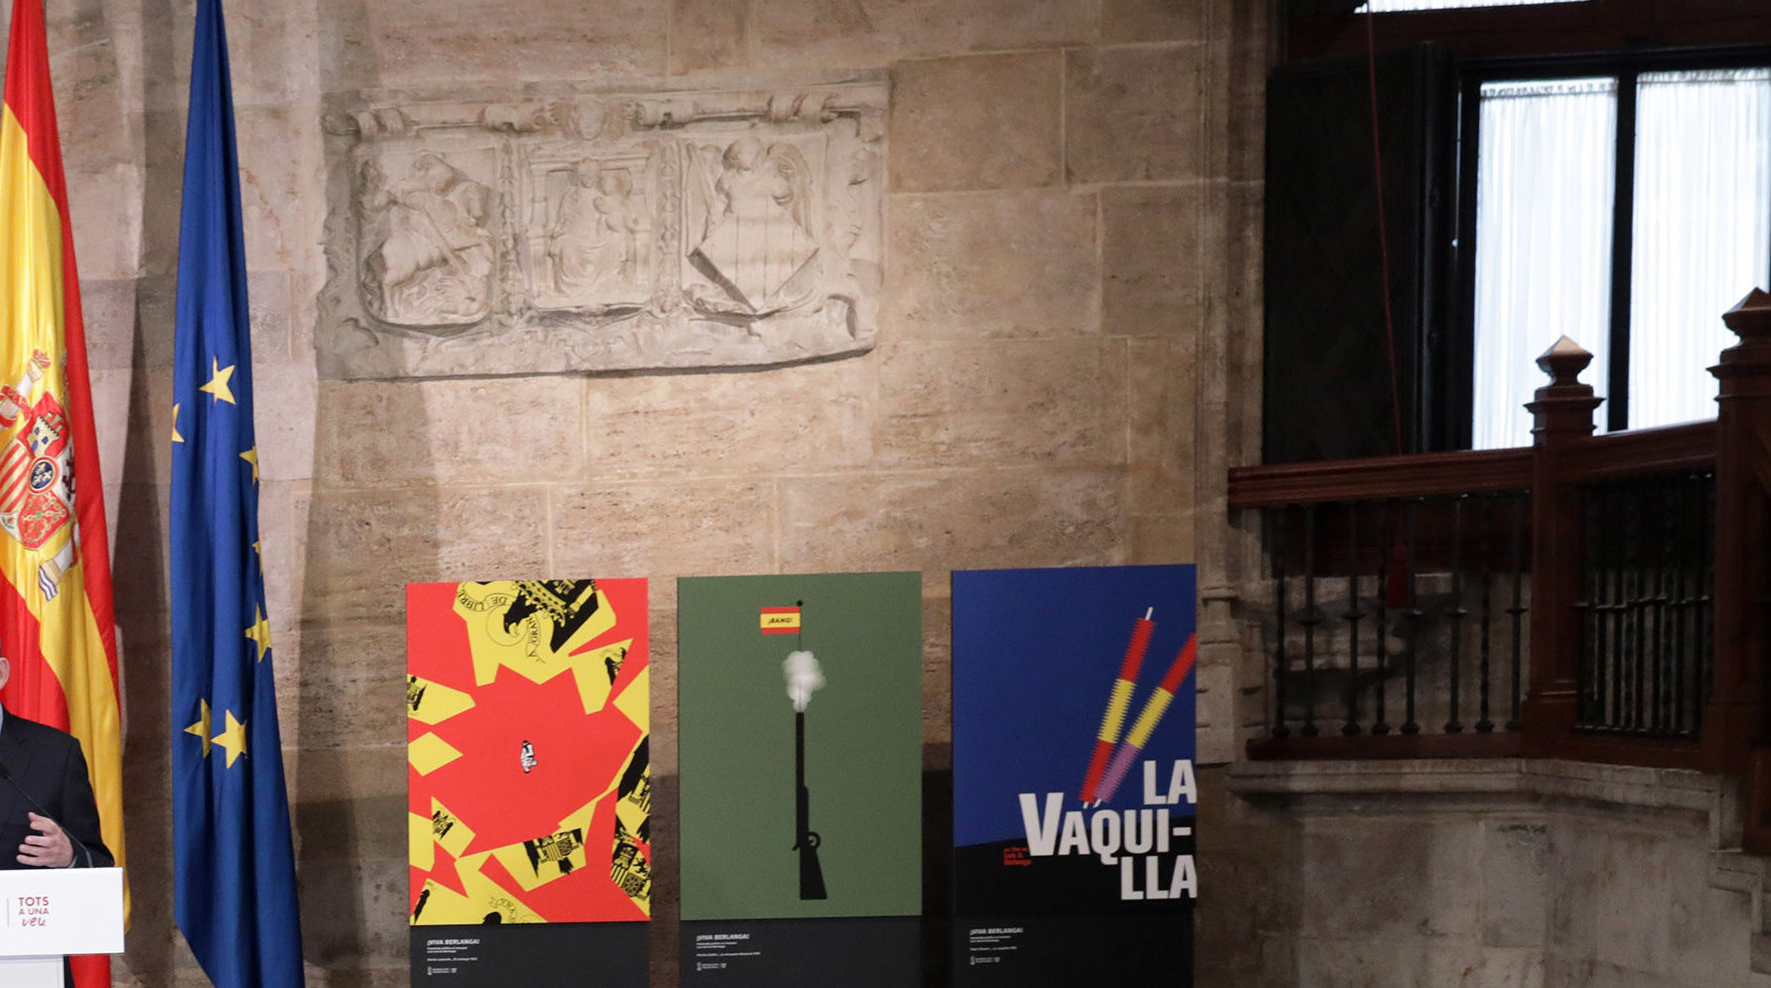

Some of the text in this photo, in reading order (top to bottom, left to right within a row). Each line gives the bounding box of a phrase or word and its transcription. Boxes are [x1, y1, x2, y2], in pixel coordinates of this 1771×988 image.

[1143, 759, 1198, 805] LA
[1121, 854, 1198, 900] LLA
[18, 896, 50, 907] TOTS
[28, 907, 50, 916] UNA
[22, 916, 47, 927] veu
